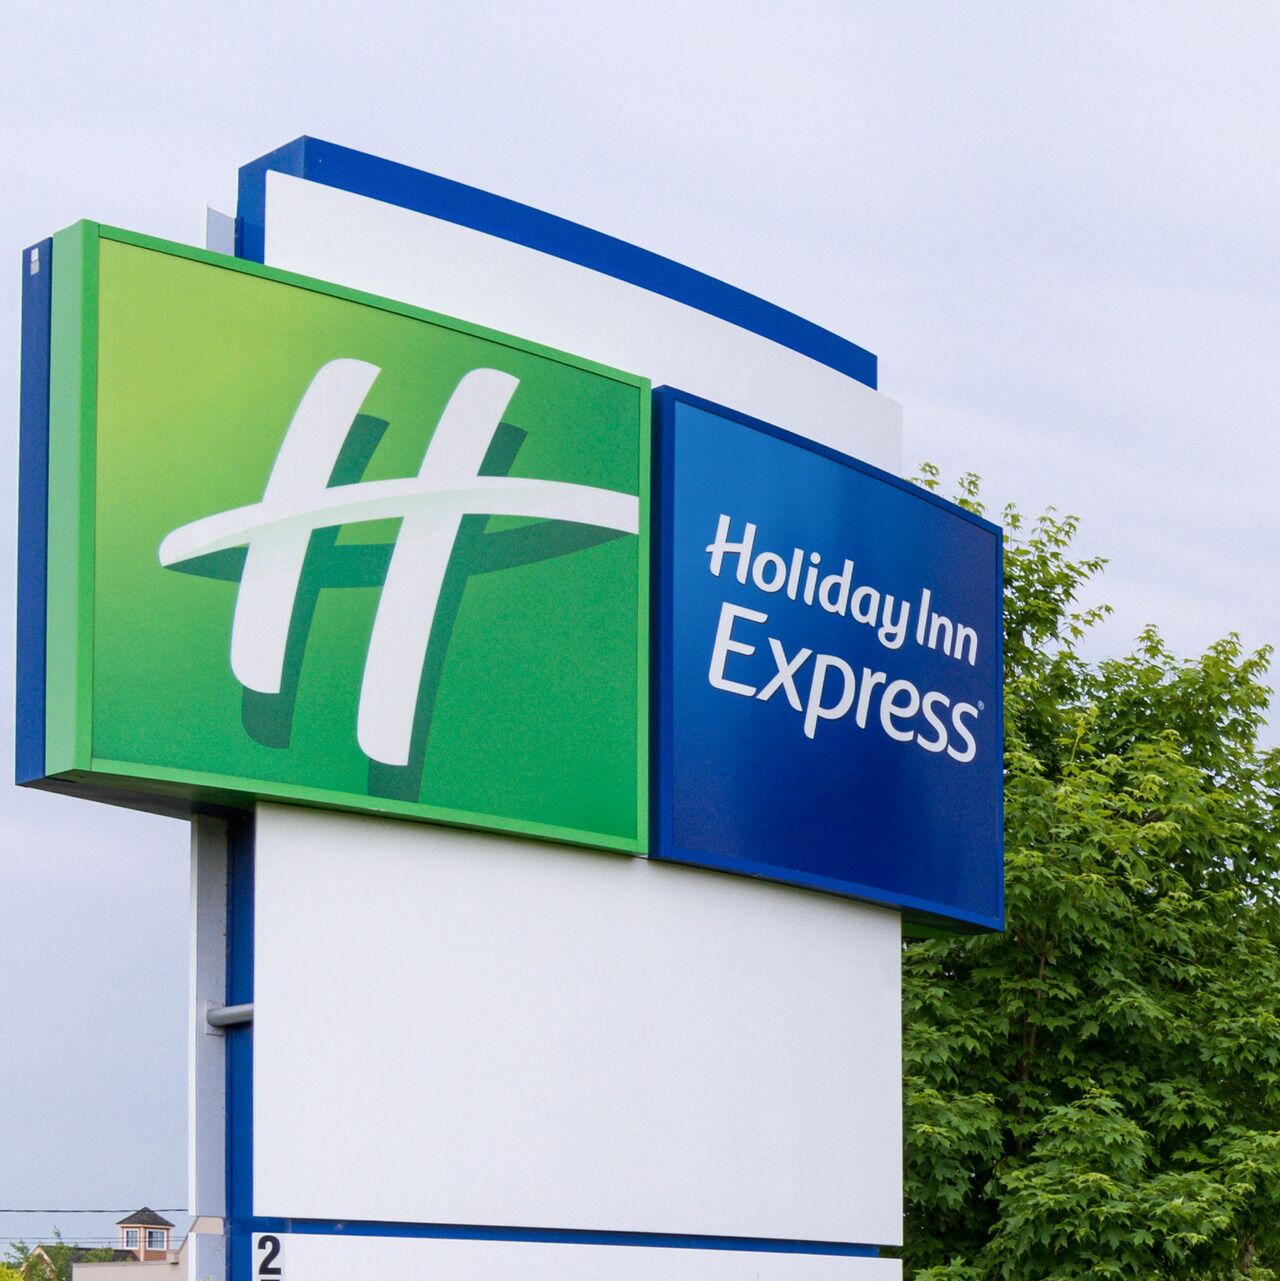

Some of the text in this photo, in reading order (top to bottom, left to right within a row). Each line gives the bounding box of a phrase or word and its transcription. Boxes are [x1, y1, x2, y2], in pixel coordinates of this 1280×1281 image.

[705, 513, 979, 667] Holiday Inn
[708, 601, 979, 763] Express
